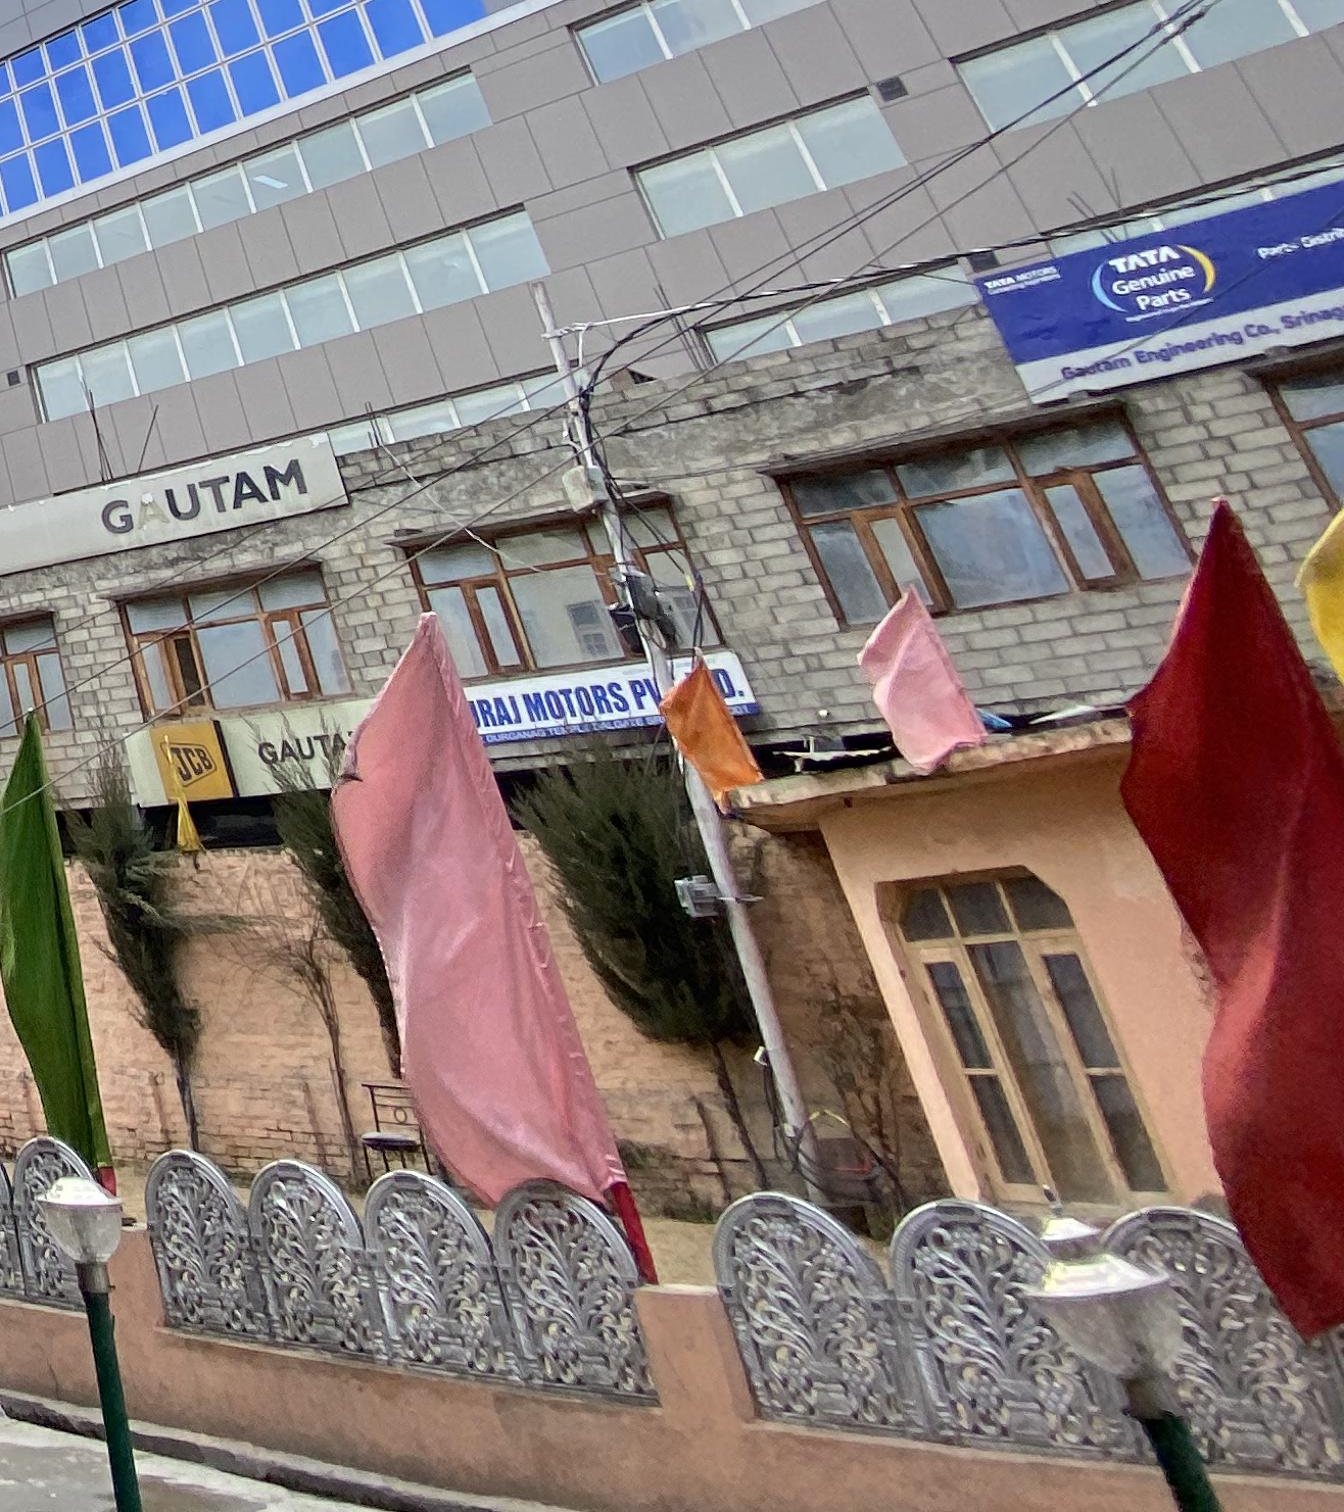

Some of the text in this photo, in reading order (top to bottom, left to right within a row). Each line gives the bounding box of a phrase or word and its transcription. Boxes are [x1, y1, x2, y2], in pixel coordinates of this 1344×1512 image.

[1108, 245, 1181, 273] TATA
[1112, 266, 1195, 295] Genuine
[1136, 288, 1192, 311] Parts
[1061, 354, 1132, 380] Gautam
[1135, 329, 1244, 364] Engineering
[521, 681, 630, 722] MOTORS
[170, 746, 213, 782] JCB
[258, 731, 353, 765] GAUTA
